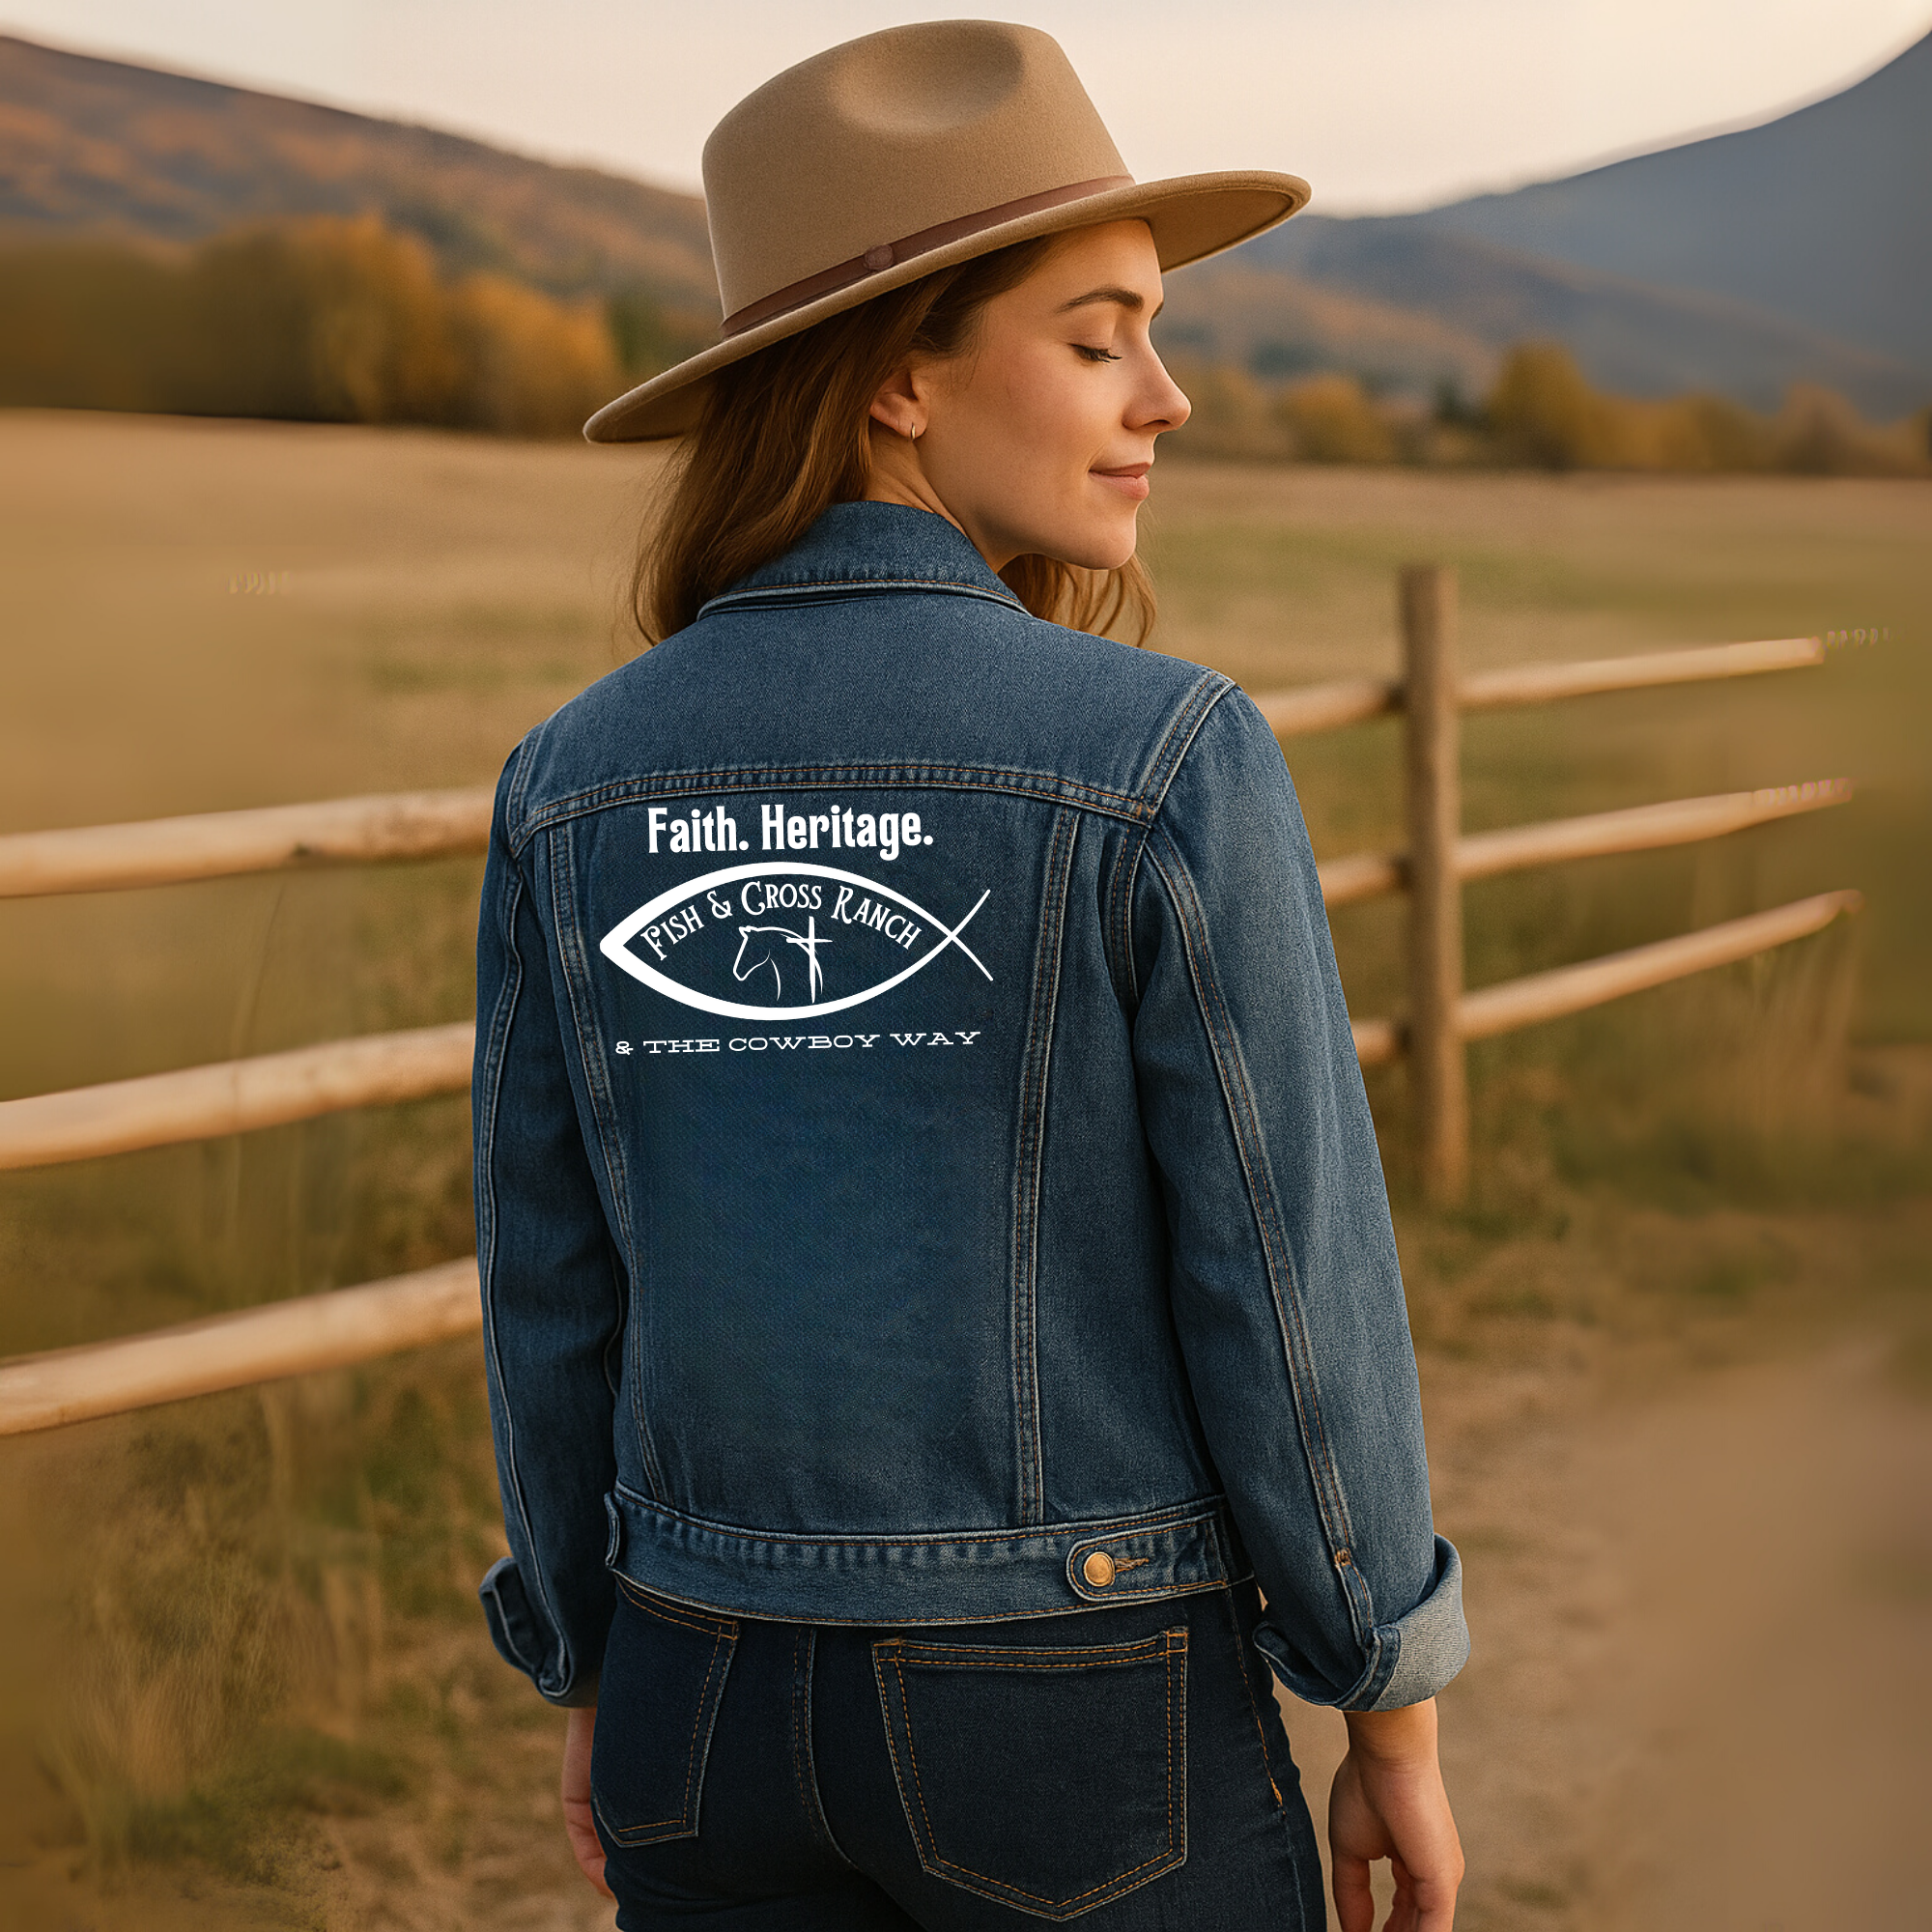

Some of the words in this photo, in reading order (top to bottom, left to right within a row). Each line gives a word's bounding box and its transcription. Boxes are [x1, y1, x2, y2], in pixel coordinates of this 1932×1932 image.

[647, 806, 750, 854] Faith.
[760, 804, 934, 863] Heritage.
[706, 890, 734, 920] &
[615, 1040, 634, 1056] &
[642, 1039, 721, 1054] THE
[728, 1035, 881, 1052] COWBOY
[889, 1031, 981, 1046] WAY
